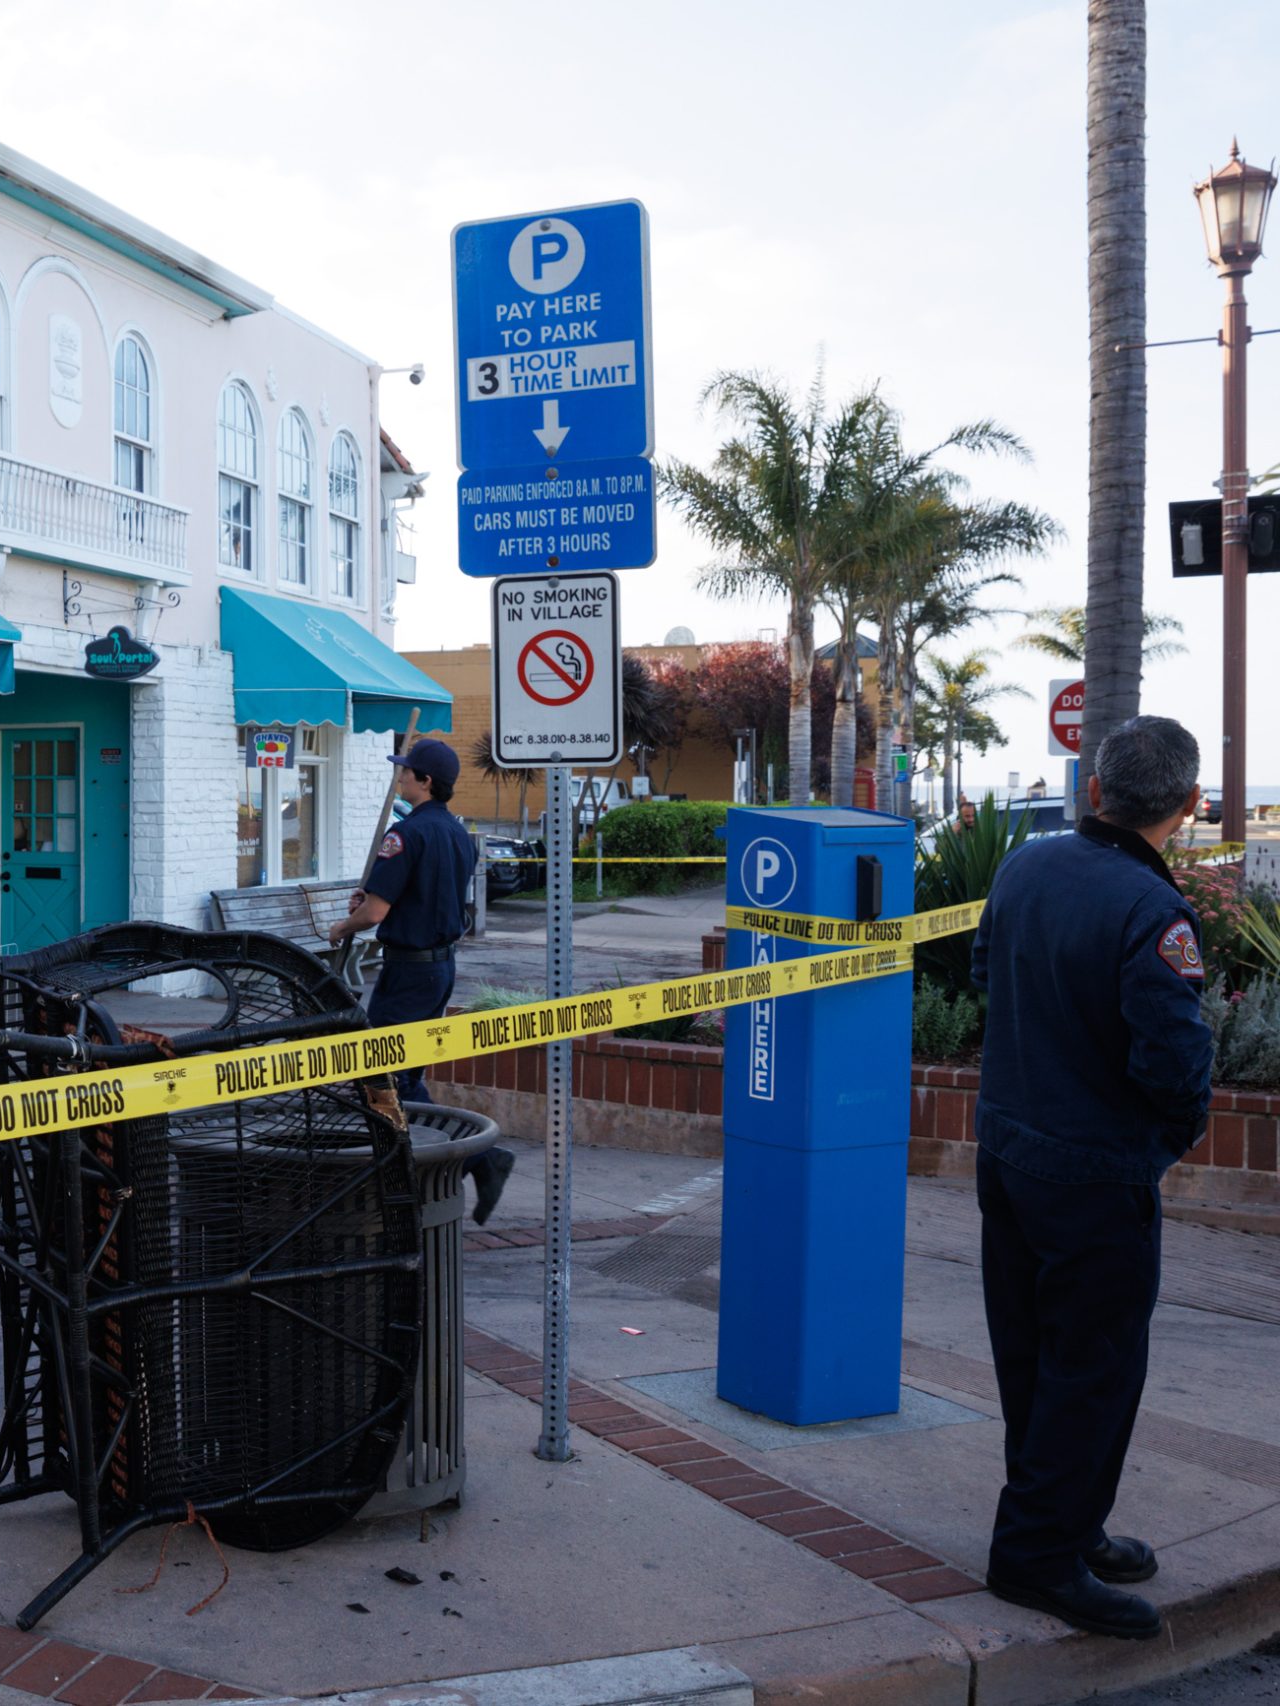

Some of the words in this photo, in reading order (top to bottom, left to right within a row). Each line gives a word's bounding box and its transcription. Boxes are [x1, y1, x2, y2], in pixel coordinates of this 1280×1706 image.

[532, 232, 569, 281] P
[496, 301, 536, 323] PAY
[544, 292, 602, 316] HERE
[500, 329, 532, 348] TO
[540, 319, 598, 344] PARK
[510, 350, 577, 374] HOUR
[477, 362, 500, 396] 3
[510, 371, 563, 394] TIME
[571, 364, 630, 388] LIMIT
[462, 487, 482, 505] PAID
[484, 483, 523, 503] PARKING
[526, 480, 573, 501] ENFORCED
[576, 478, 603, 497] 8A.M.
[605, 477, 619, 495] TO
[621, 474, 647, 494] 8P.M.
[474, 511, 511, 532] CARS
[516, 508, 557, 529] MUST
[561, 507, 578, 526] BE
[583, 503, 635, 524] MOVED
[498, 536, 543, 557] AFTER
[547, 536, 556, 554] 3
[560, 532, 611, 552] HOURS
[502, 591, 525, 605] NO
[533, 587, 608, 604] SMOKING
[507, 608, 523, 622] IN
[531, 604, 603, 620] VILLAGE
[90, 653, 112, 664] Soul
[119, 653, 153, 664] Portal
[1062, 694, 1083, 707] DO
[255, 733, 290, 744] SHAVED
[503, 734, 523, 745] CMC
[527, 733, 611, 745] 8.38.010-8.38.140
[257, 756, 285, 767] ICE
[756, 850, 780, 894] P
[743, 911, 780, 931] POLICE
[783, 918, 814, 939] LINE
[818, 922, 834, 940] DO
[837, 922, 864, 941] NOT
[865, 921, 902, 942] CROSS
[756, 931, 771, 966] PA
[810, 959, 833, 985] POLICE
[835, 956, 850, 979] LINE
[851, 954, 861, 976] DO
[662, 985, 692, 1013] POLICE
[694, 981, 712, 1007] LINE
[714, 979, 726, 1003] DO
[728, 976, 744, 1000] NOT
[746, 971, 771, 997] CROSS
[426, 1025, 451, 1038] SIRCHIE
[471, 1016, 510, 1049] POLICE
[513, 1012, 537, 1042] LINE
[539, 1009, 554, 1036] DO
[557, 1005, 577, 1034] NOT
[580, 998, 613, 1029] CROSS
[755, 1003, 770, 1093] HERE
[153, 1068, 187, 1082] SIRCHIE
[215, 1056, 269, 1095] POLICE
[271, 1051, 305, 1086] LINE
[308, 1047, 328, 1077] DO
[330, 1041, 360, 1075] NOT
[363, 1033, 407, 1069] CROSS
[21, 1085, 61, 1128] NOT
[65, 1078, 125, 1118] CROSS
